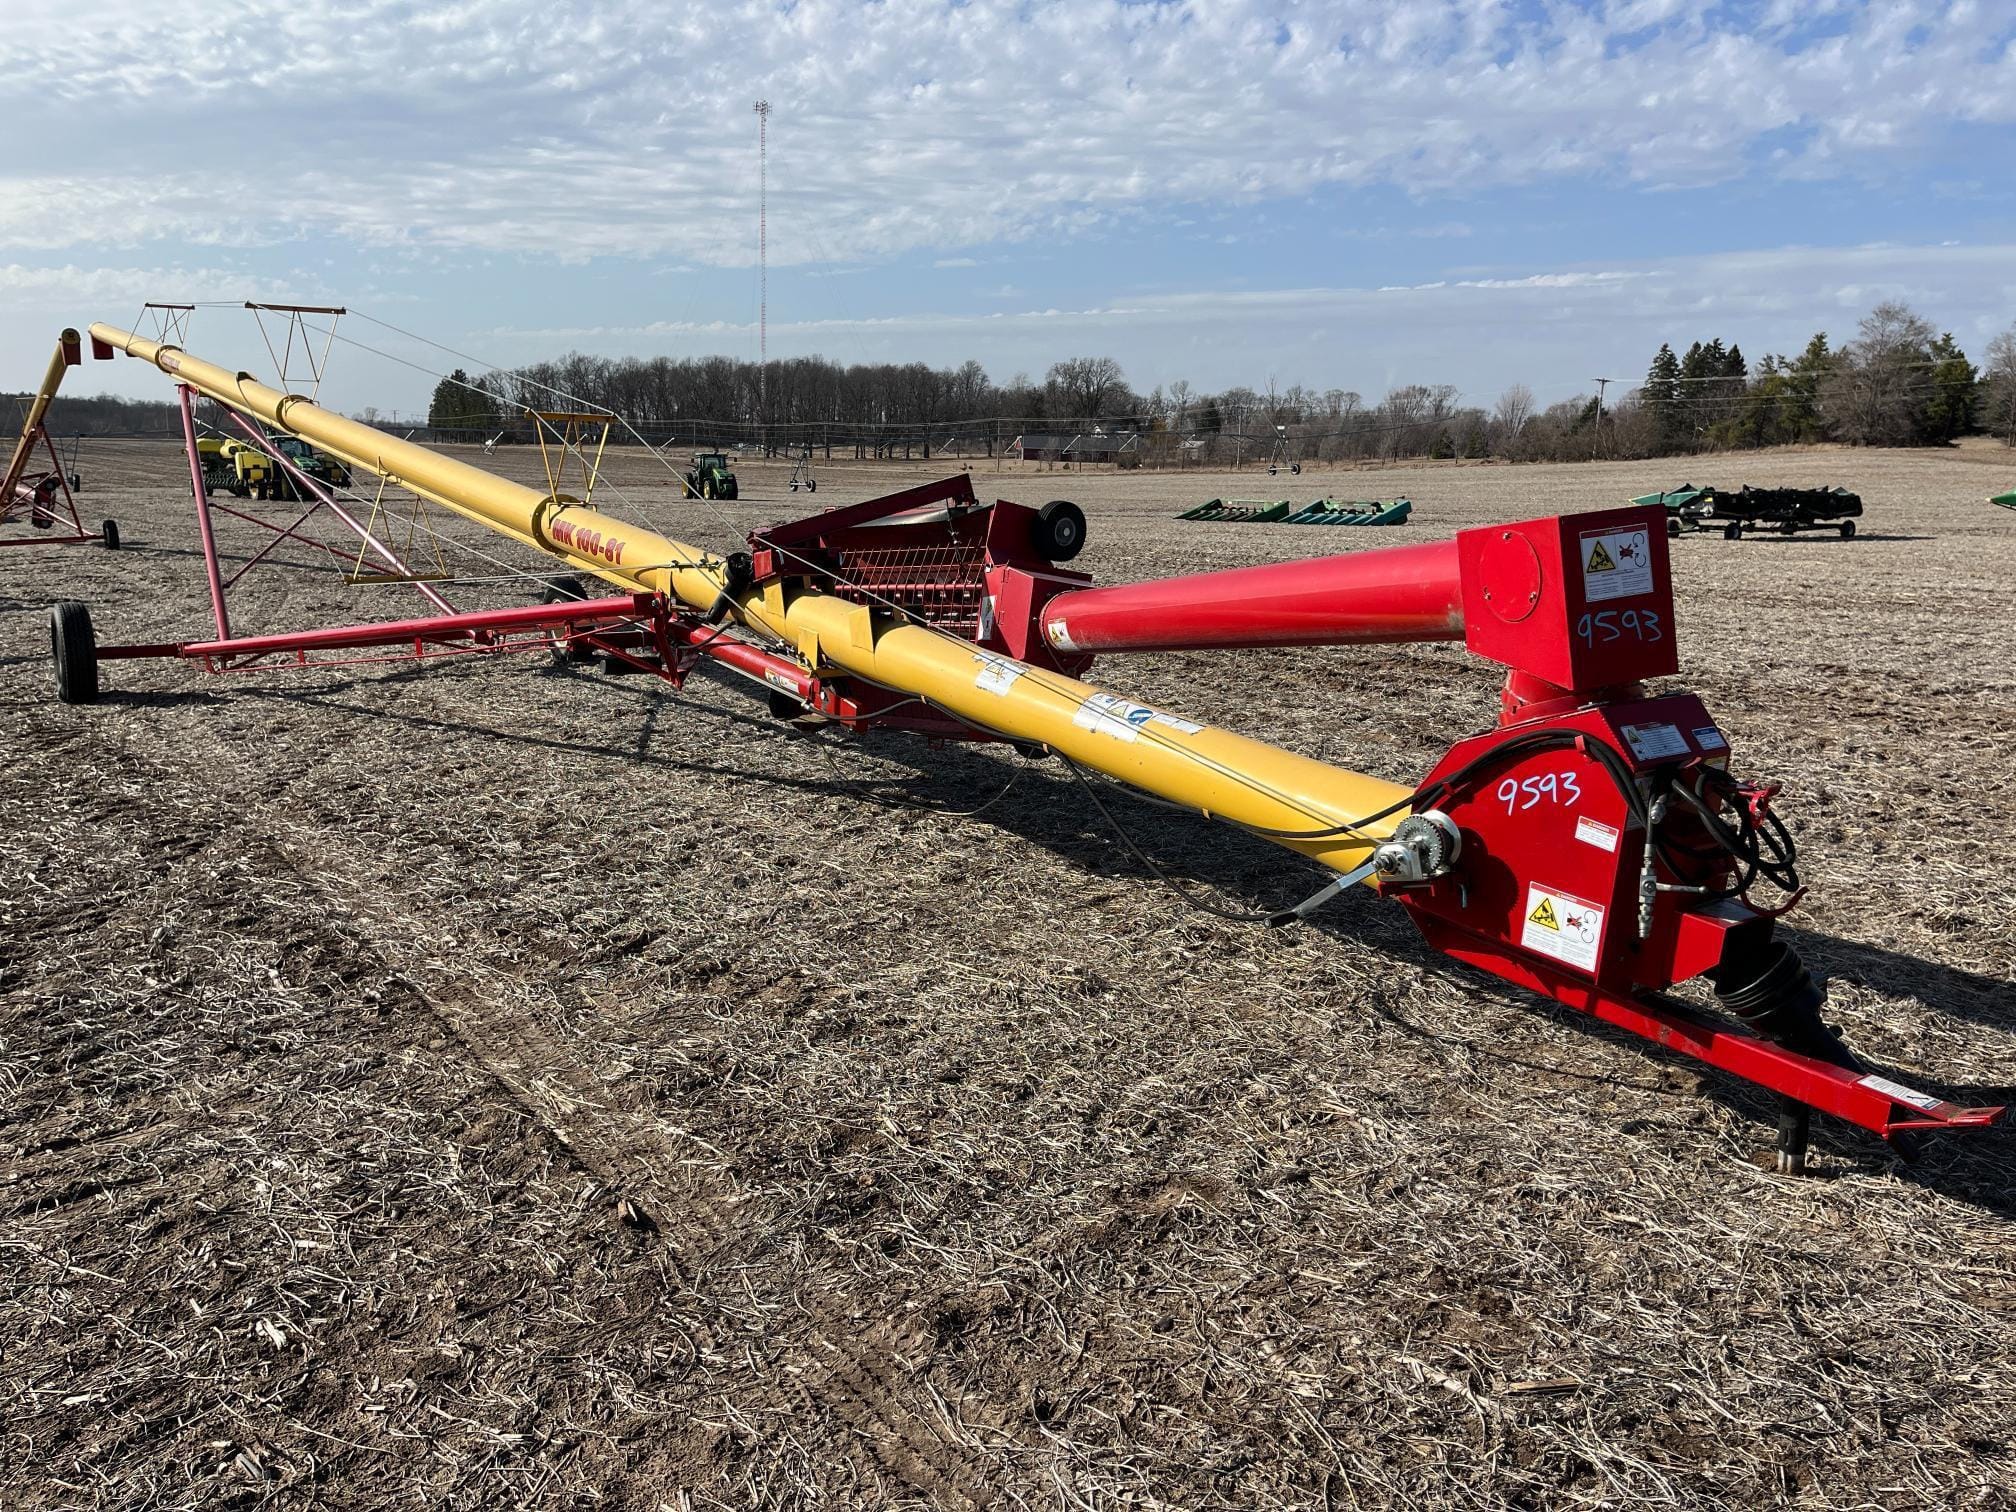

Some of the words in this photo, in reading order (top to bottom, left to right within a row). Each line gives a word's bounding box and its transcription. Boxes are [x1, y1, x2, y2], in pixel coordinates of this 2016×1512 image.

[552, 519, 576, 546] MK
[576, 528, 626, 565] 100-81
[1577, 610, 1662, 648] 9593
[1497, 772, 1581, 816] 9593
